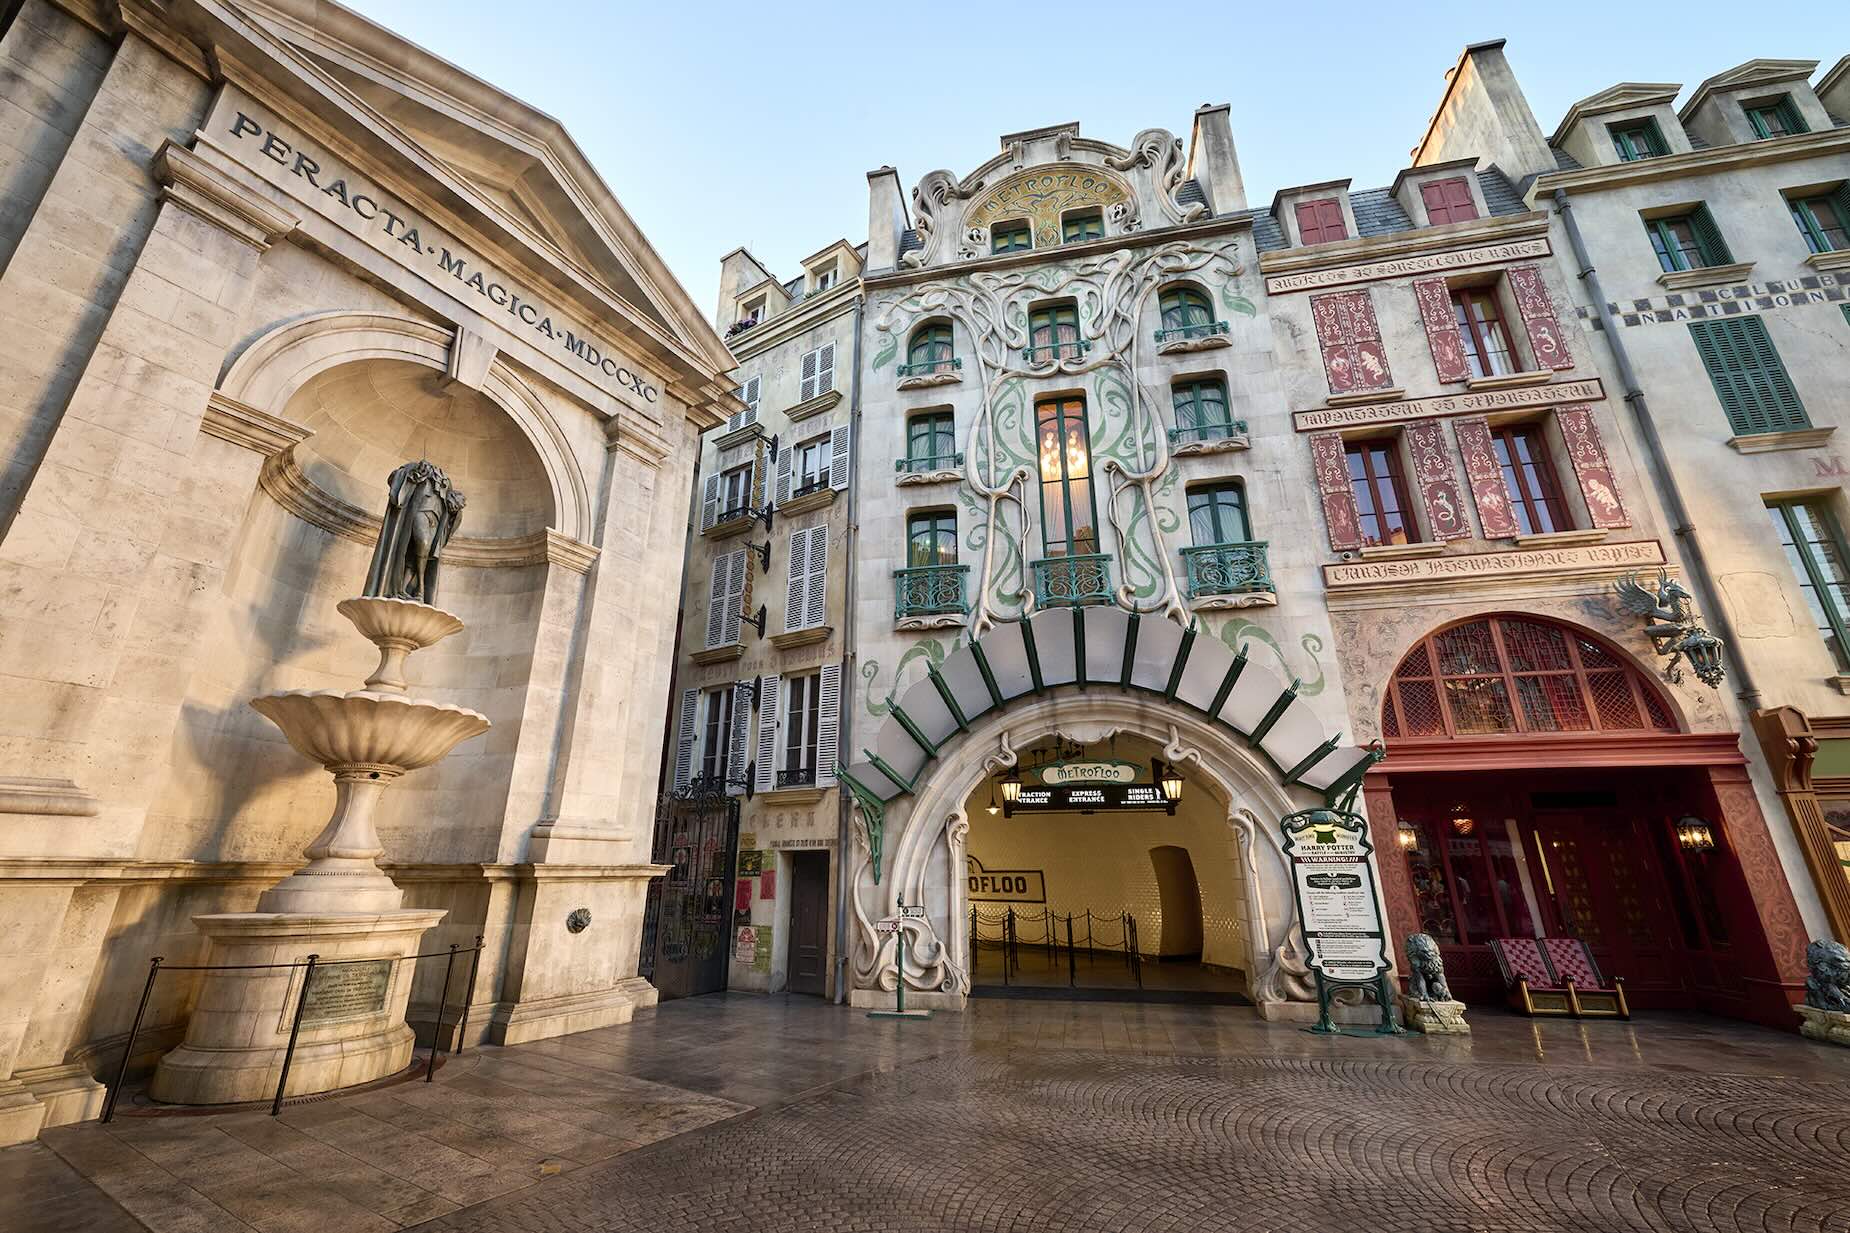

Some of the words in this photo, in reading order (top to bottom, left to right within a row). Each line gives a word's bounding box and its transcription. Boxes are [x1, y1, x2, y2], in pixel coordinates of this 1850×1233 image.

[229, 112, 423, 255] PERACTA
[437, 248, 555, 340] MAGICA
[563, 330, 658, 404] MDCCXC
[984, 175, 1108, 212] METROFLOO
